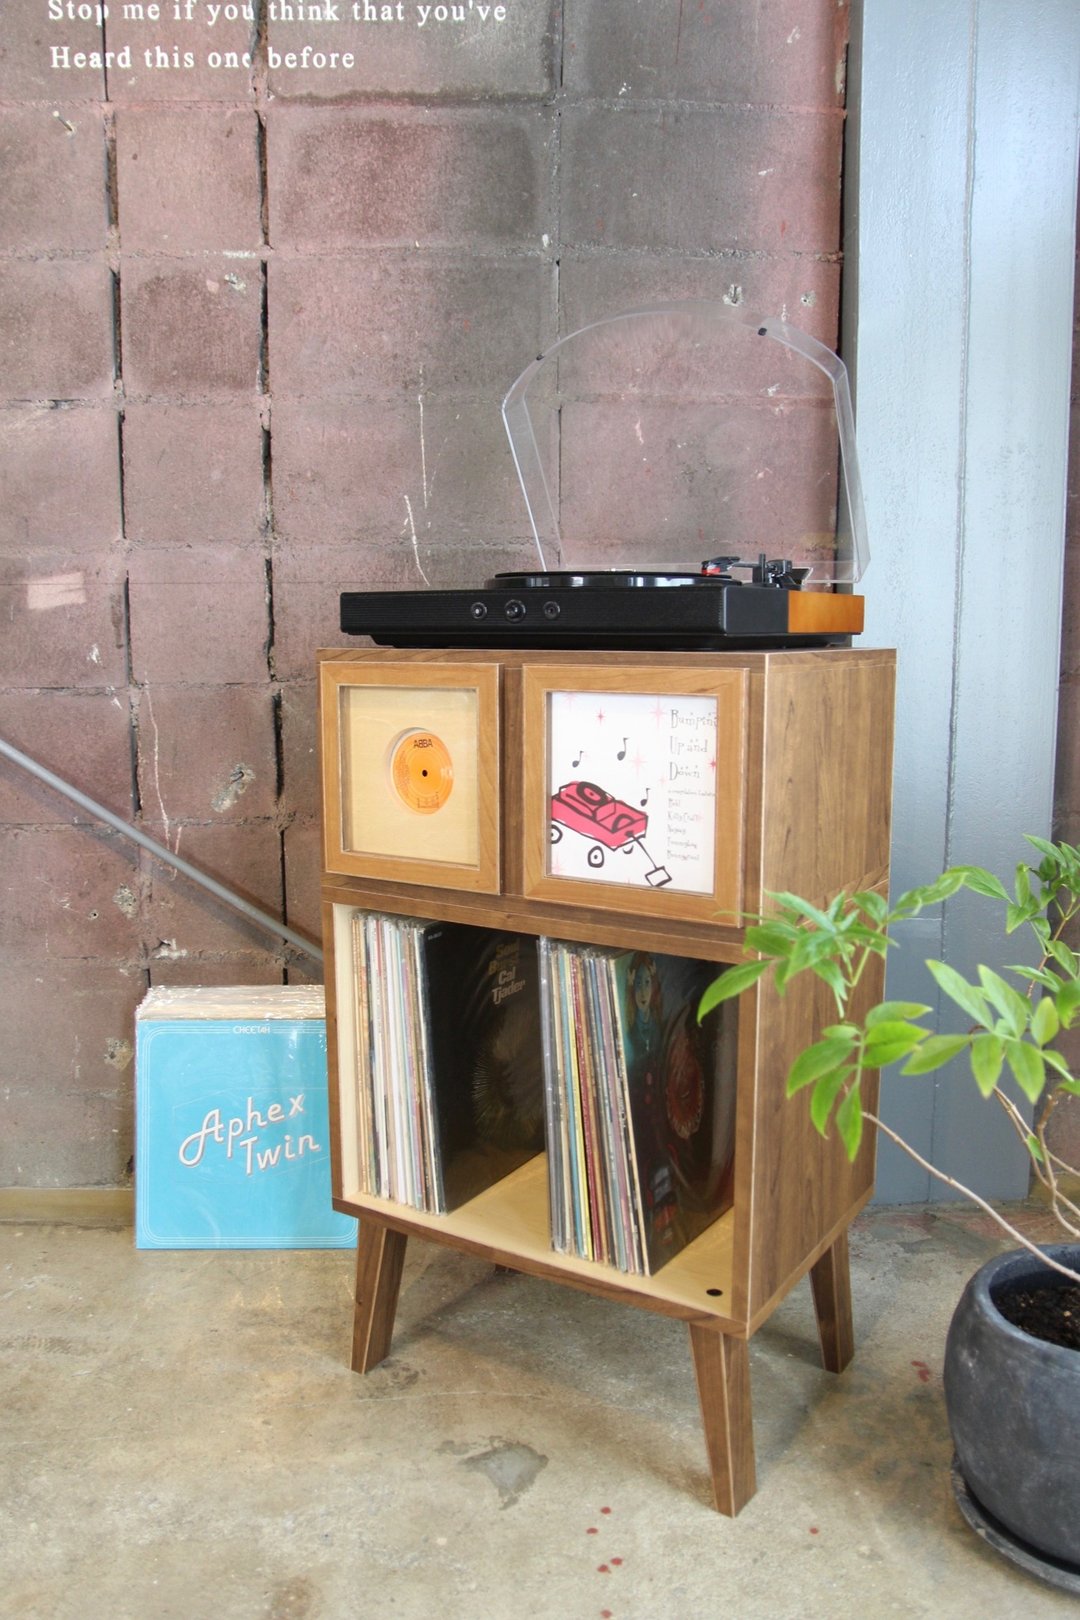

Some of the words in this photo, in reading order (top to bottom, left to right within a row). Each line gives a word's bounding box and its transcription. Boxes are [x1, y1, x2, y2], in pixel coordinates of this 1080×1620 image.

[48, 0, 110, 27] Stop
[123, 4, 160, 20] me
[173, 0, 197, 20] if
[207, 4, 255, 26] you
[269, 0, 340, 21] think
[352, 0, 405, 21] that
[417, 0, 507, 26] you've
[50, 46, 132, 68] Heard
[144, 46, 195, 68] this
[267, 46, 355, 69] before
[413, 738, 433, 748] ABBA
[496, 937, 521, 959] Soul
[498, 966, 517, 985] Cal
[491, 979, 526, 1005] Tjader
[178, 1091, 306, 1168] Aphex
[239, 1132, 321, 1176] Twin
